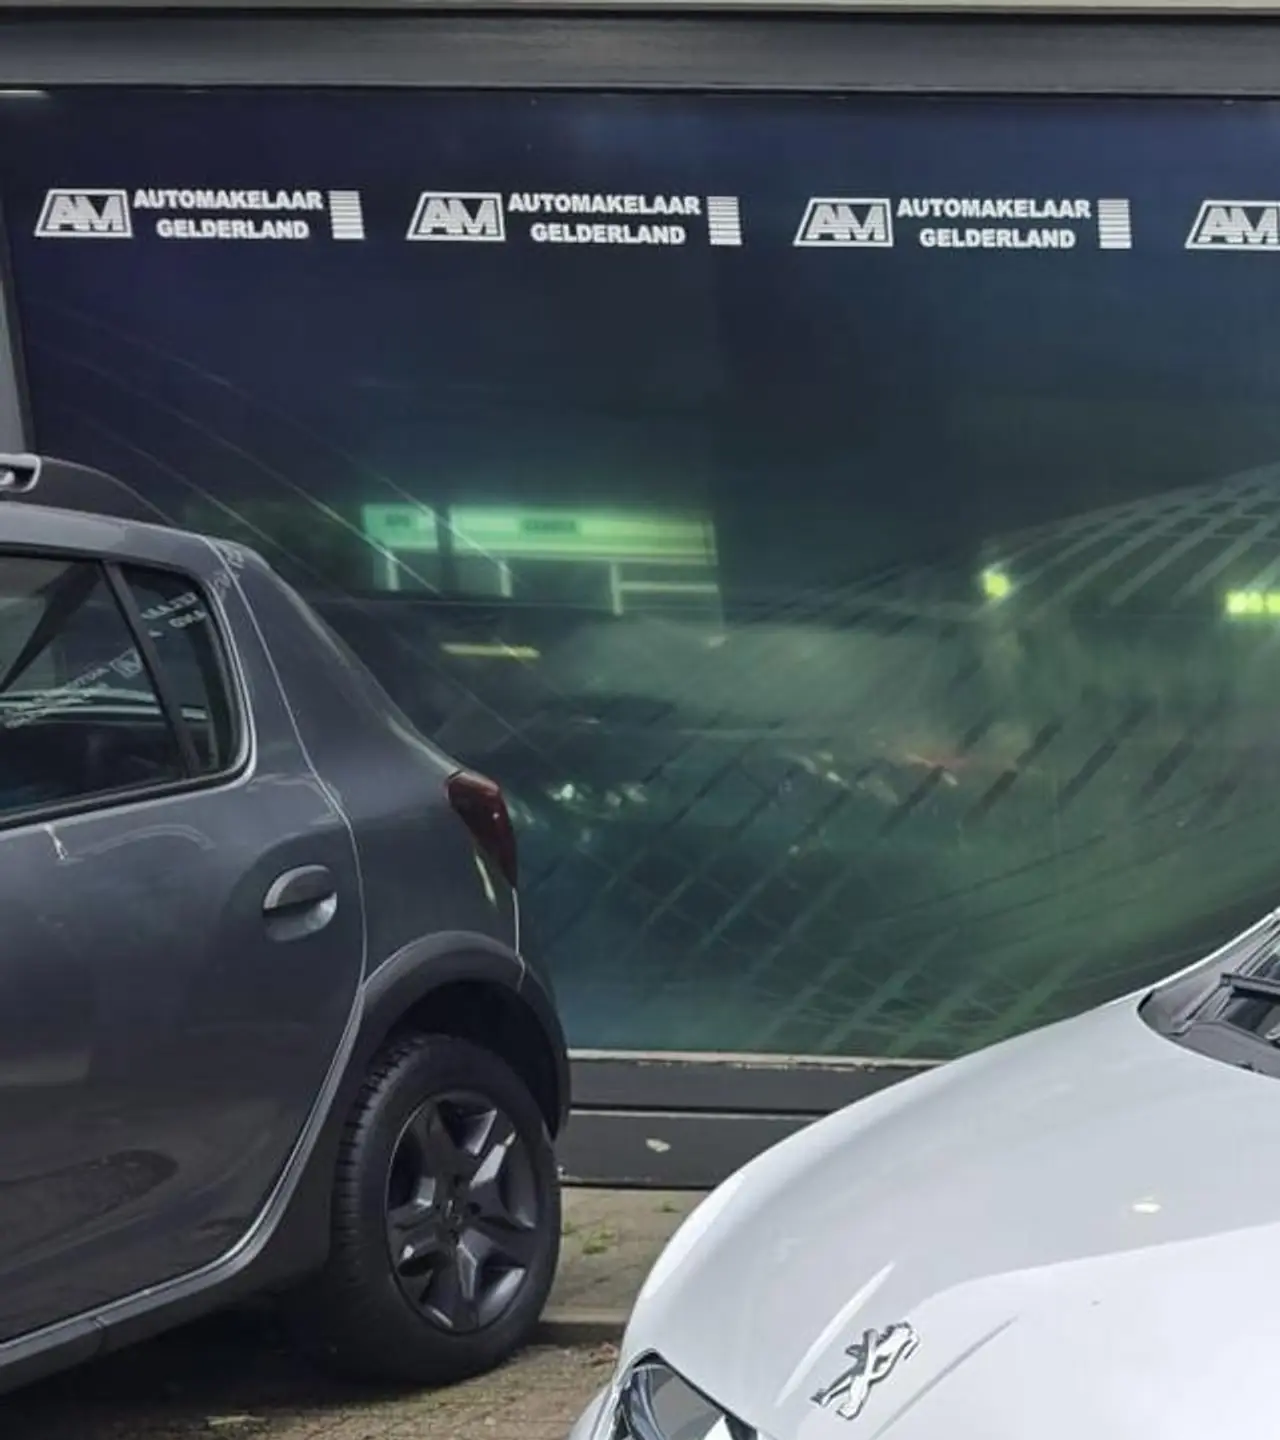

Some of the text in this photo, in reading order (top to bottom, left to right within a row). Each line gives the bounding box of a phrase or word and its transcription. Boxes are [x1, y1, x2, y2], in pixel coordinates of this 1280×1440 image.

[133, 188, 324, 210] AUTOMAKELAAR
[507, 192, 702, 216] AUTOMAKELAAR
[896, 197, 1092, 219] AUTOMAKELAAR
[156, 218, 310, 240] GELDERLAND
[530, 222, 686, 245] GELDERLAND
[919, 227, 1077, 249] GELDERLAND
